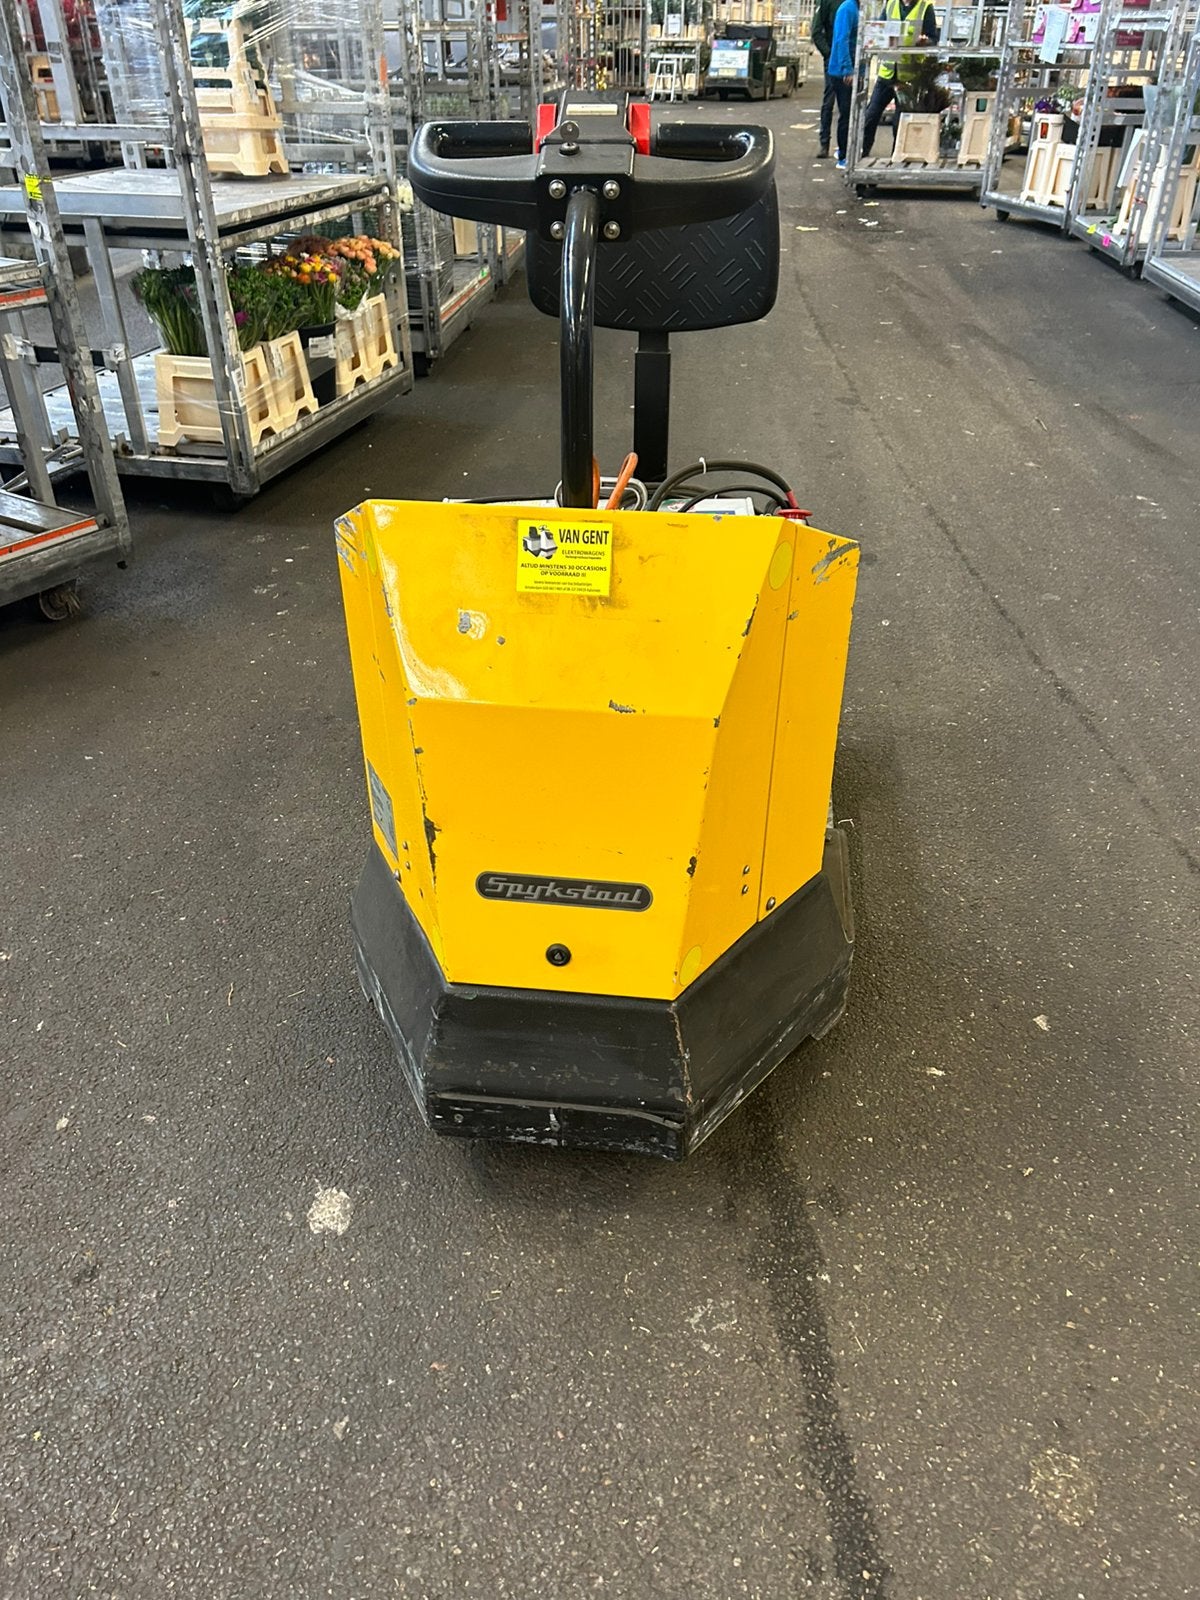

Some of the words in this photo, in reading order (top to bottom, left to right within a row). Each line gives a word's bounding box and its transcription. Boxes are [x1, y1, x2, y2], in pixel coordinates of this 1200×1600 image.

[559, 529, 580, 544] VAN
[582, 530, 610, 545] GENT
[562, 549, 605, 557] ELEKTROWAGENS
[484, 876, 643, 905] Spykstaal
